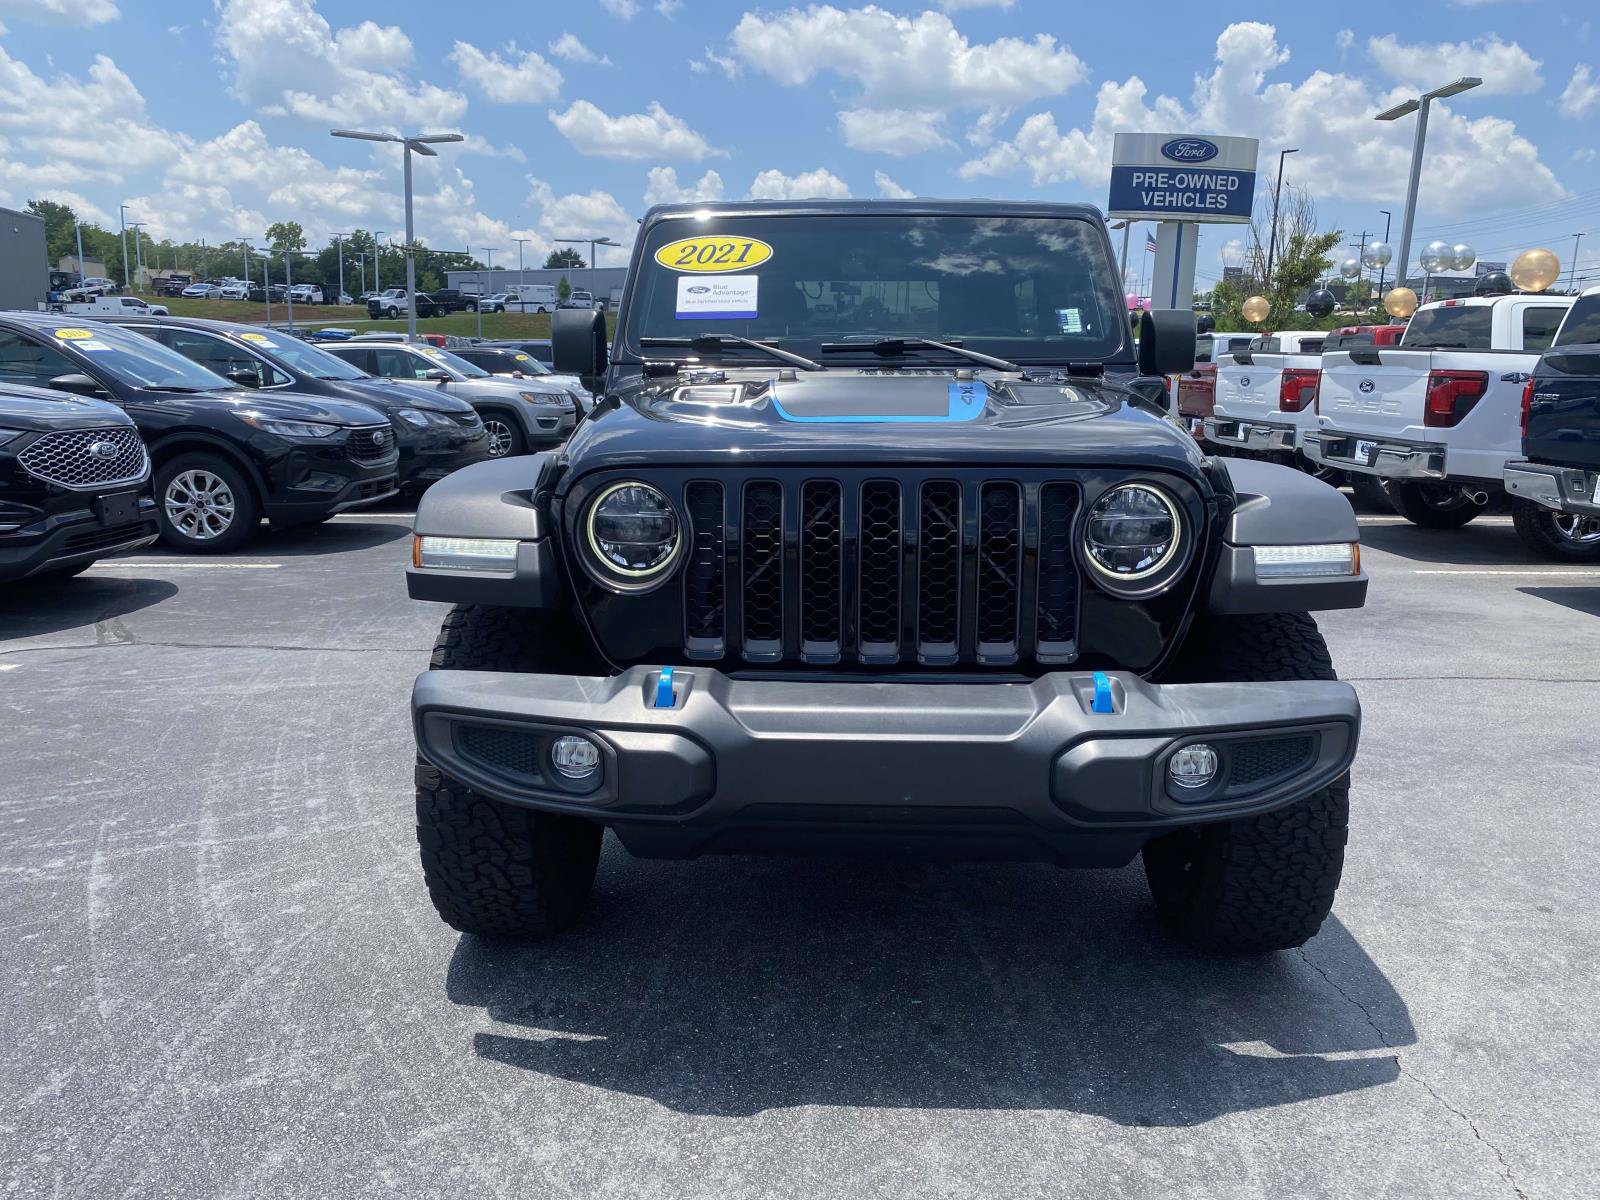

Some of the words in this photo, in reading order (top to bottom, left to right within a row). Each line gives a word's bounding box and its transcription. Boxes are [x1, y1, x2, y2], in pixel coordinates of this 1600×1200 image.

[1174, 142, 1208, 157] Ford
[1132, 172, 1239, 191] PRE-OWNED
[1141, 191, 1228, 209] VEHICLES
[674, 242, 754, 266] 2021
